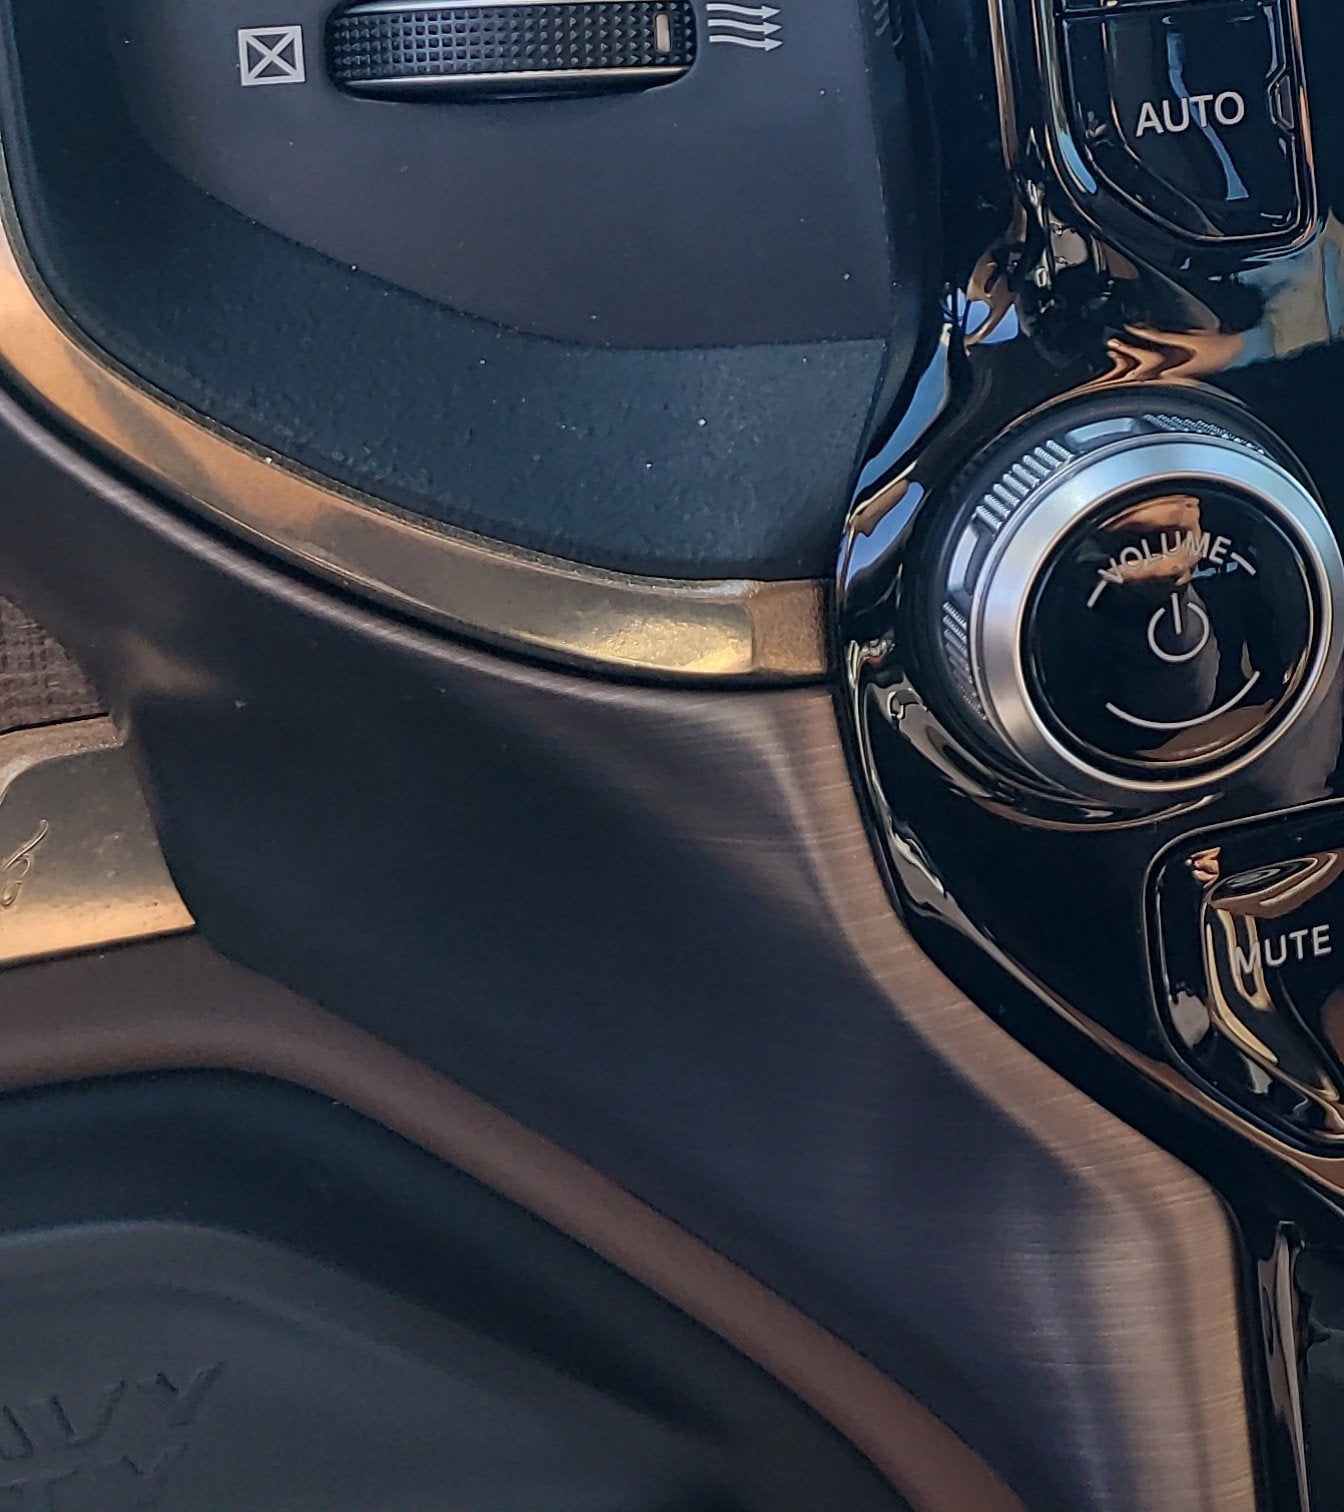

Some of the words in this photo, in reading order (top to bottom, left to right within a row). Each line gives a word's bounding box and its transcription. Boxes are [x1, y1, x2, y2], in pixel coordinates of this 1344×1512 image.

[1134, 90, 1246, 138] AUTO
[1097, 529, 1234, 585] VOLUME
[1234, 923, 1333, 976] MUTE
